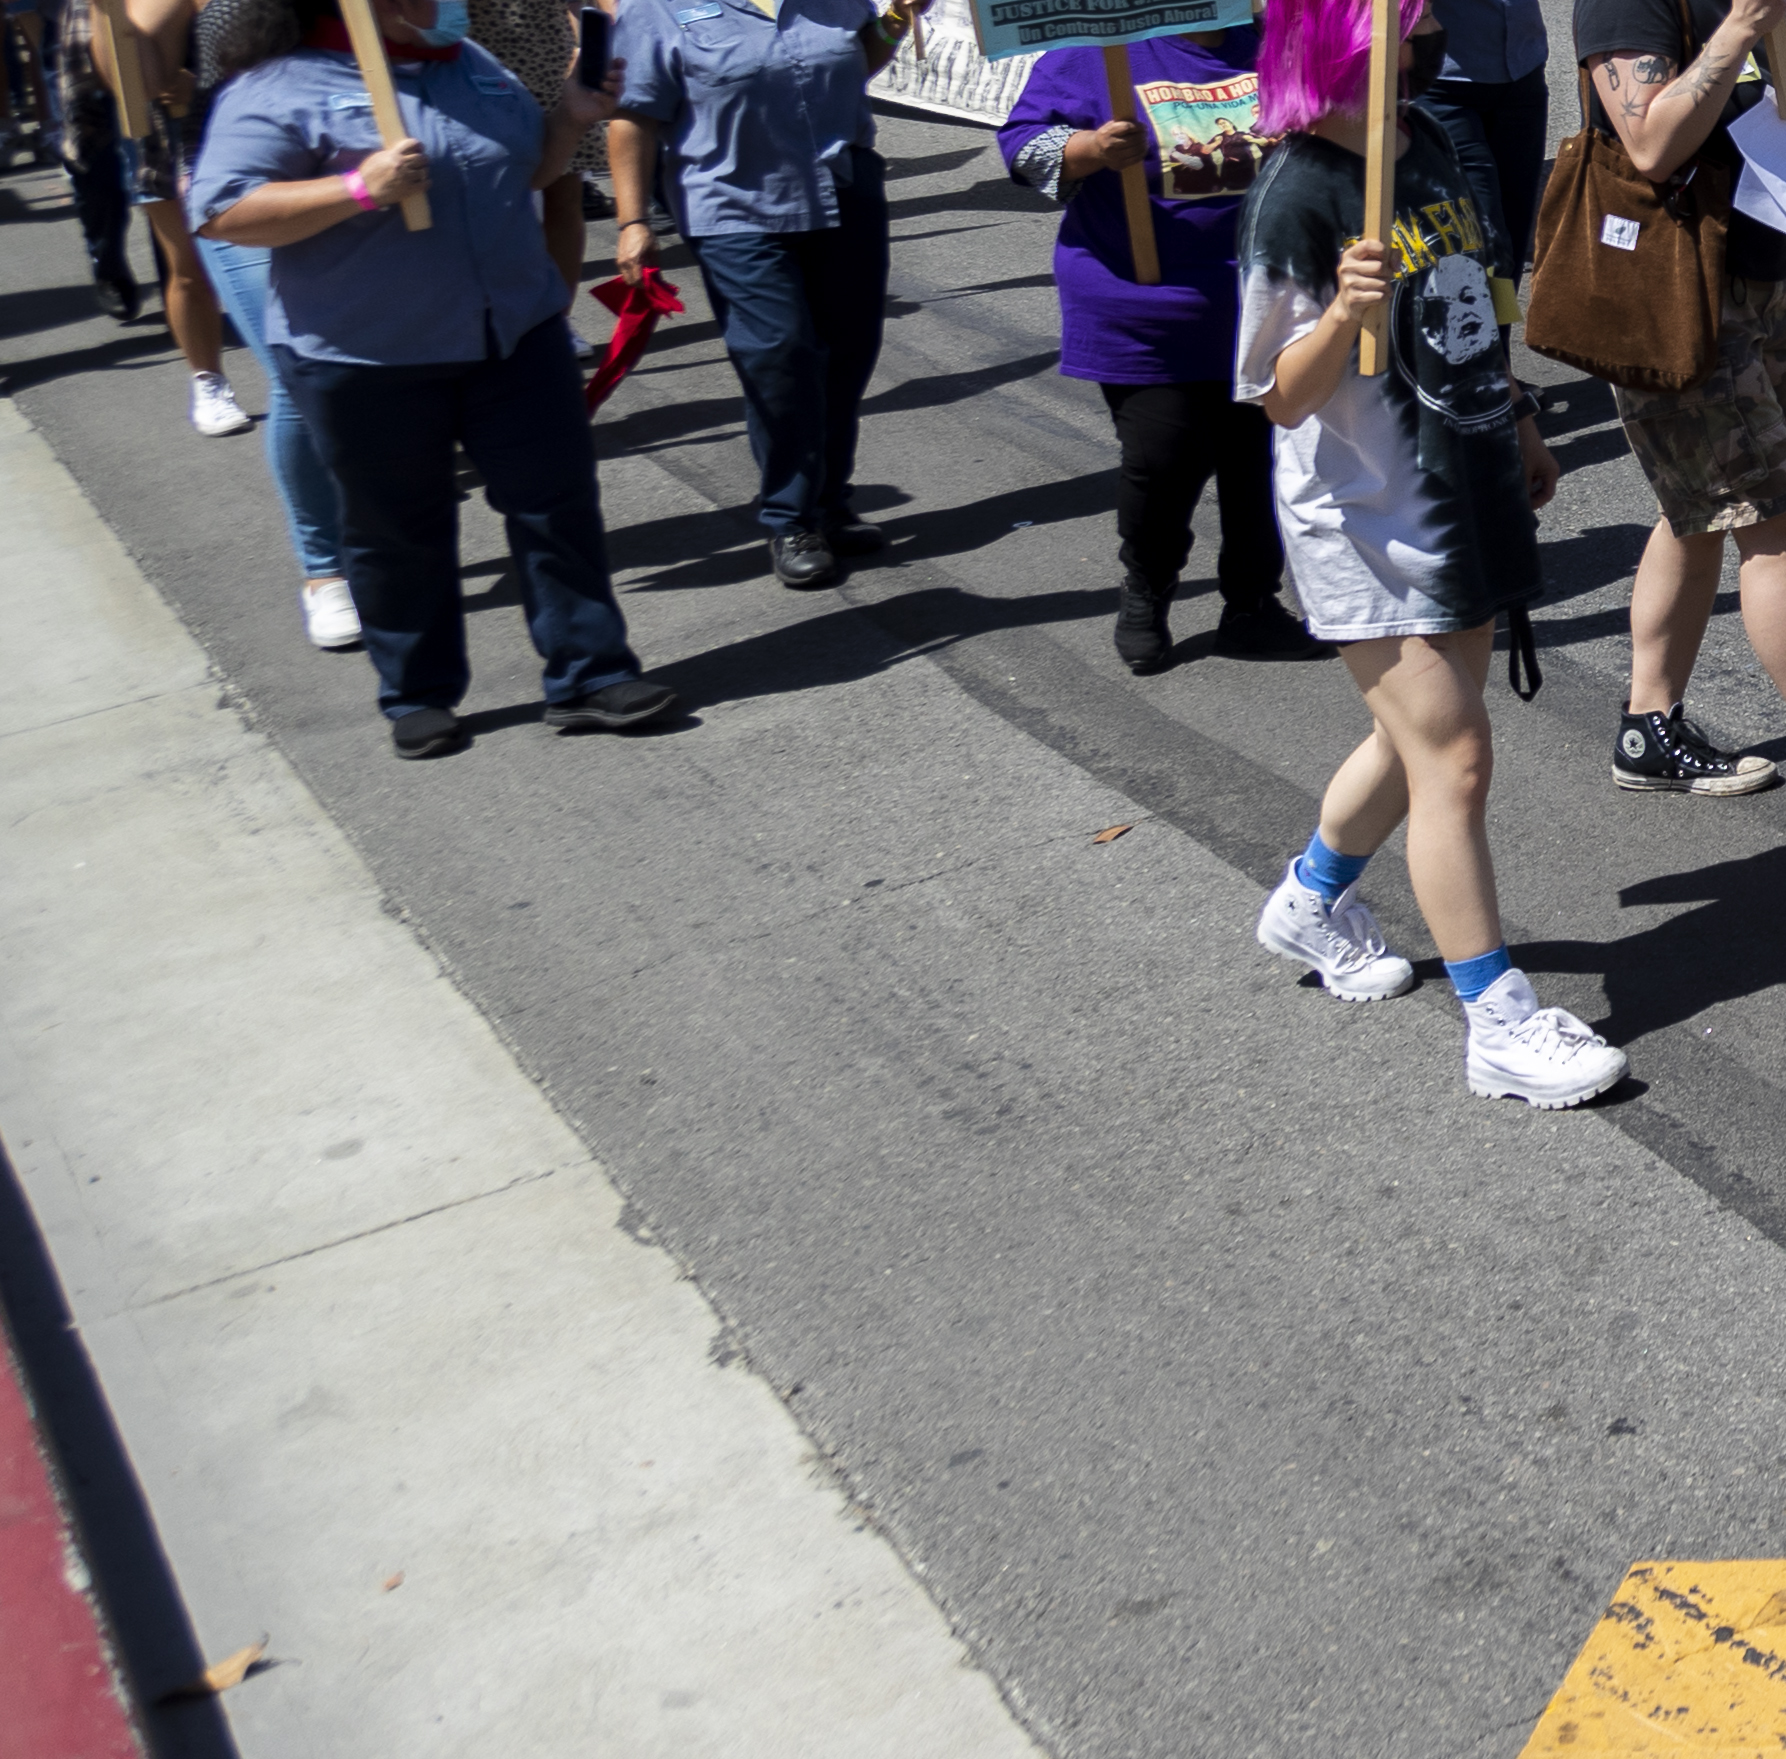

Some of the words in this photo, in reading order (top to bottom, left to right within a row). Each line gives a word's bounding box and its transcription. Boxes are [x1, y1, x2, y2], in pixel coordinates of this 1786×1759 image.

[1018, 26, 1042, 42] Un
[1118, 11, 1161, 35] Justo
[1164, 3, 1219, 24] Ahora!
[1218, 82, 1227, 94] A
[1199, 103, 1218, 111] UNA
[1220, 98, 1245, 110] VIDA
